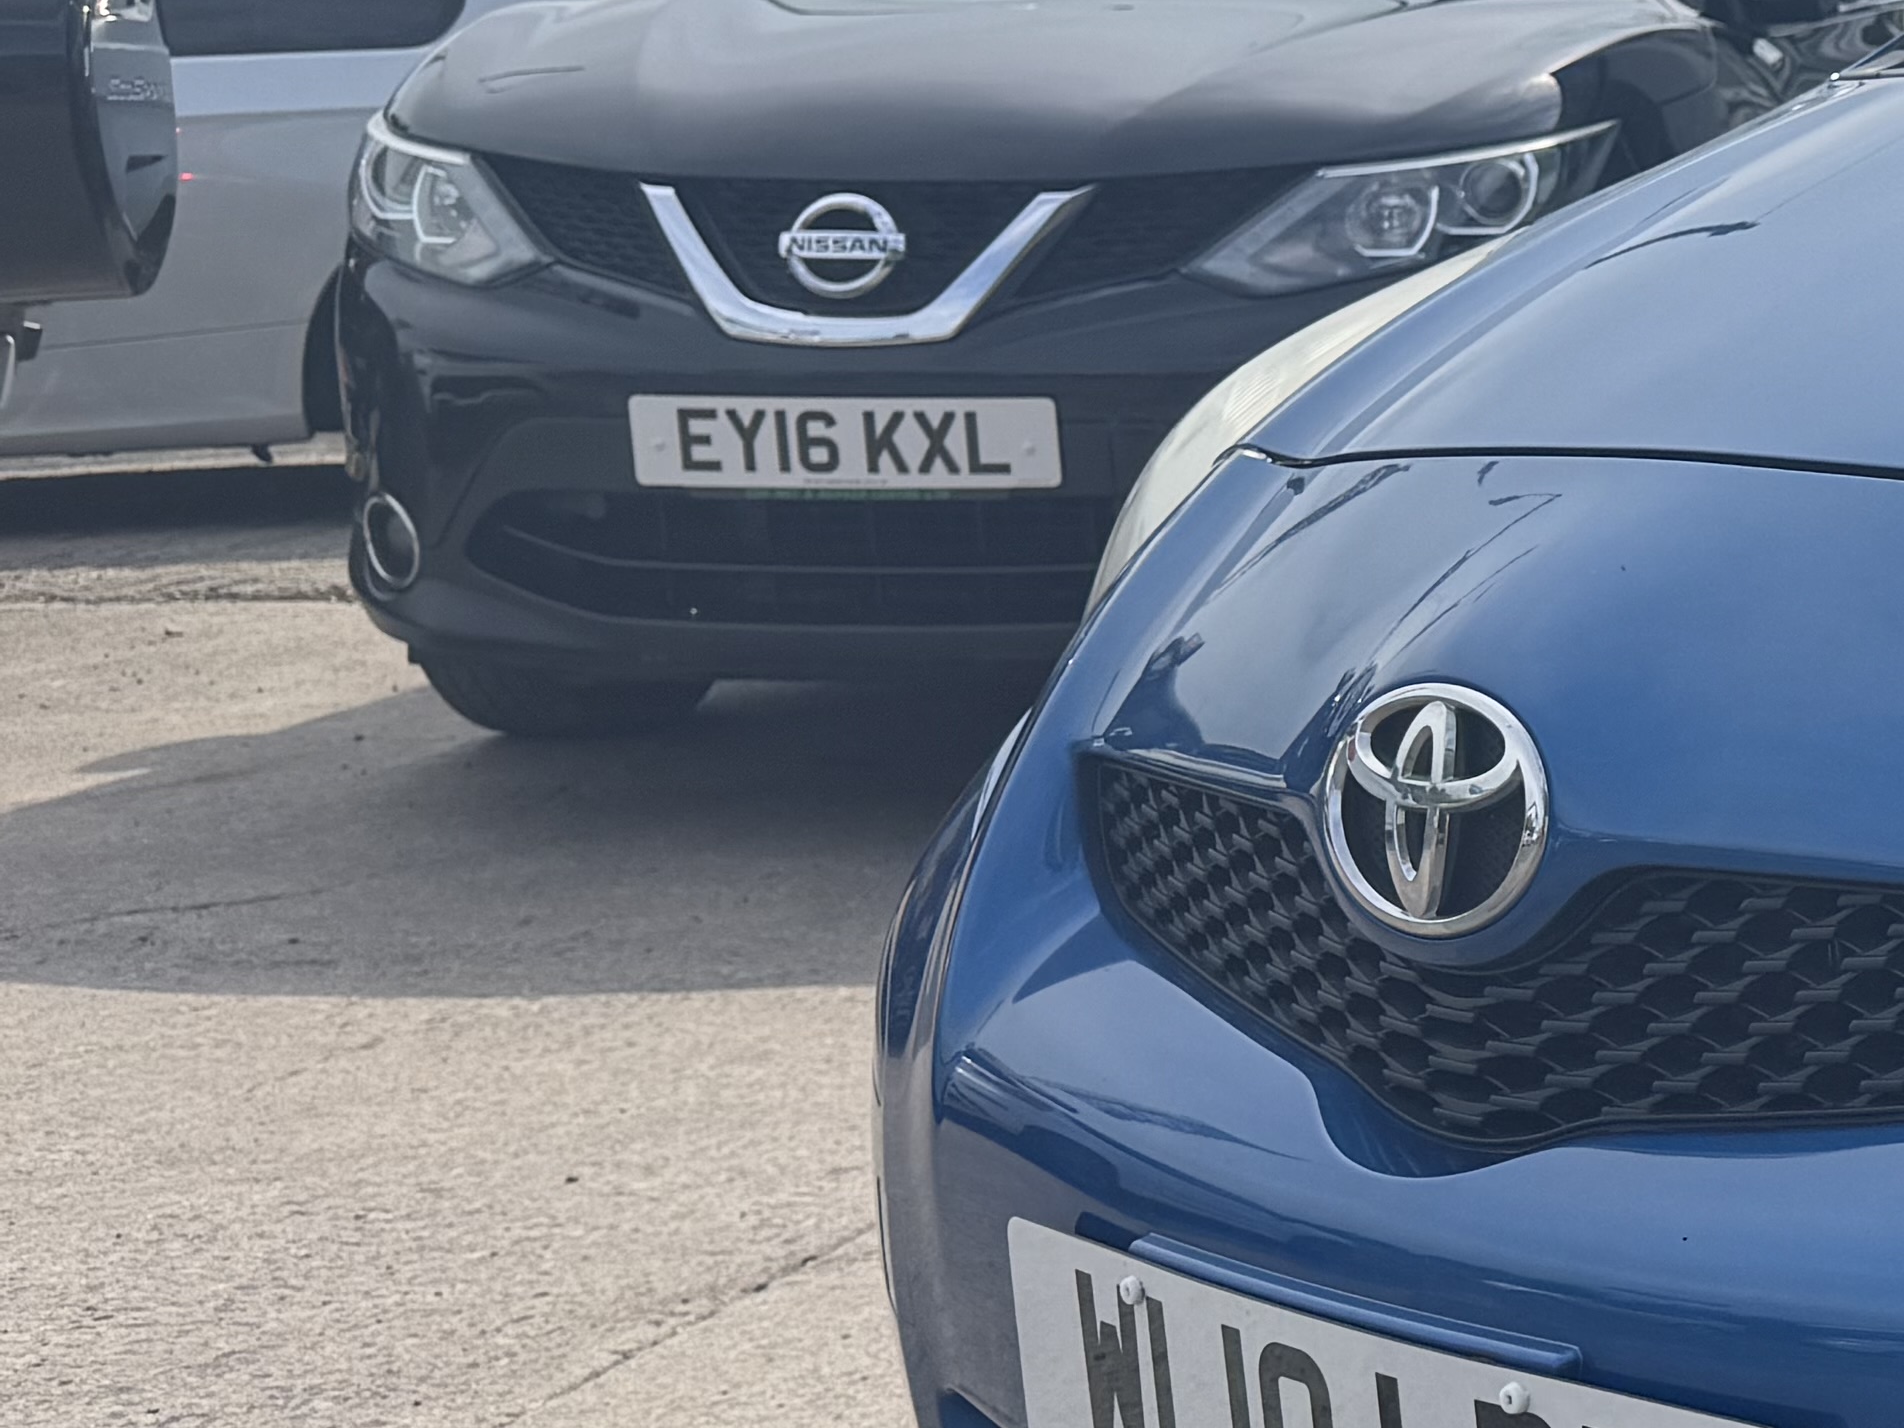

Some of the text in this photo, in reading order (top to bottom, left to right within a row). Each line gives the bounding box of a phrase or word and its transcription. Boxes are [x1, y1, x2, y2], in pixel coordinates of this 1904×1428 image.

[786, 236, 889, 254] NISSAN
[677, 408, 1012, 475] EY16 KXL
